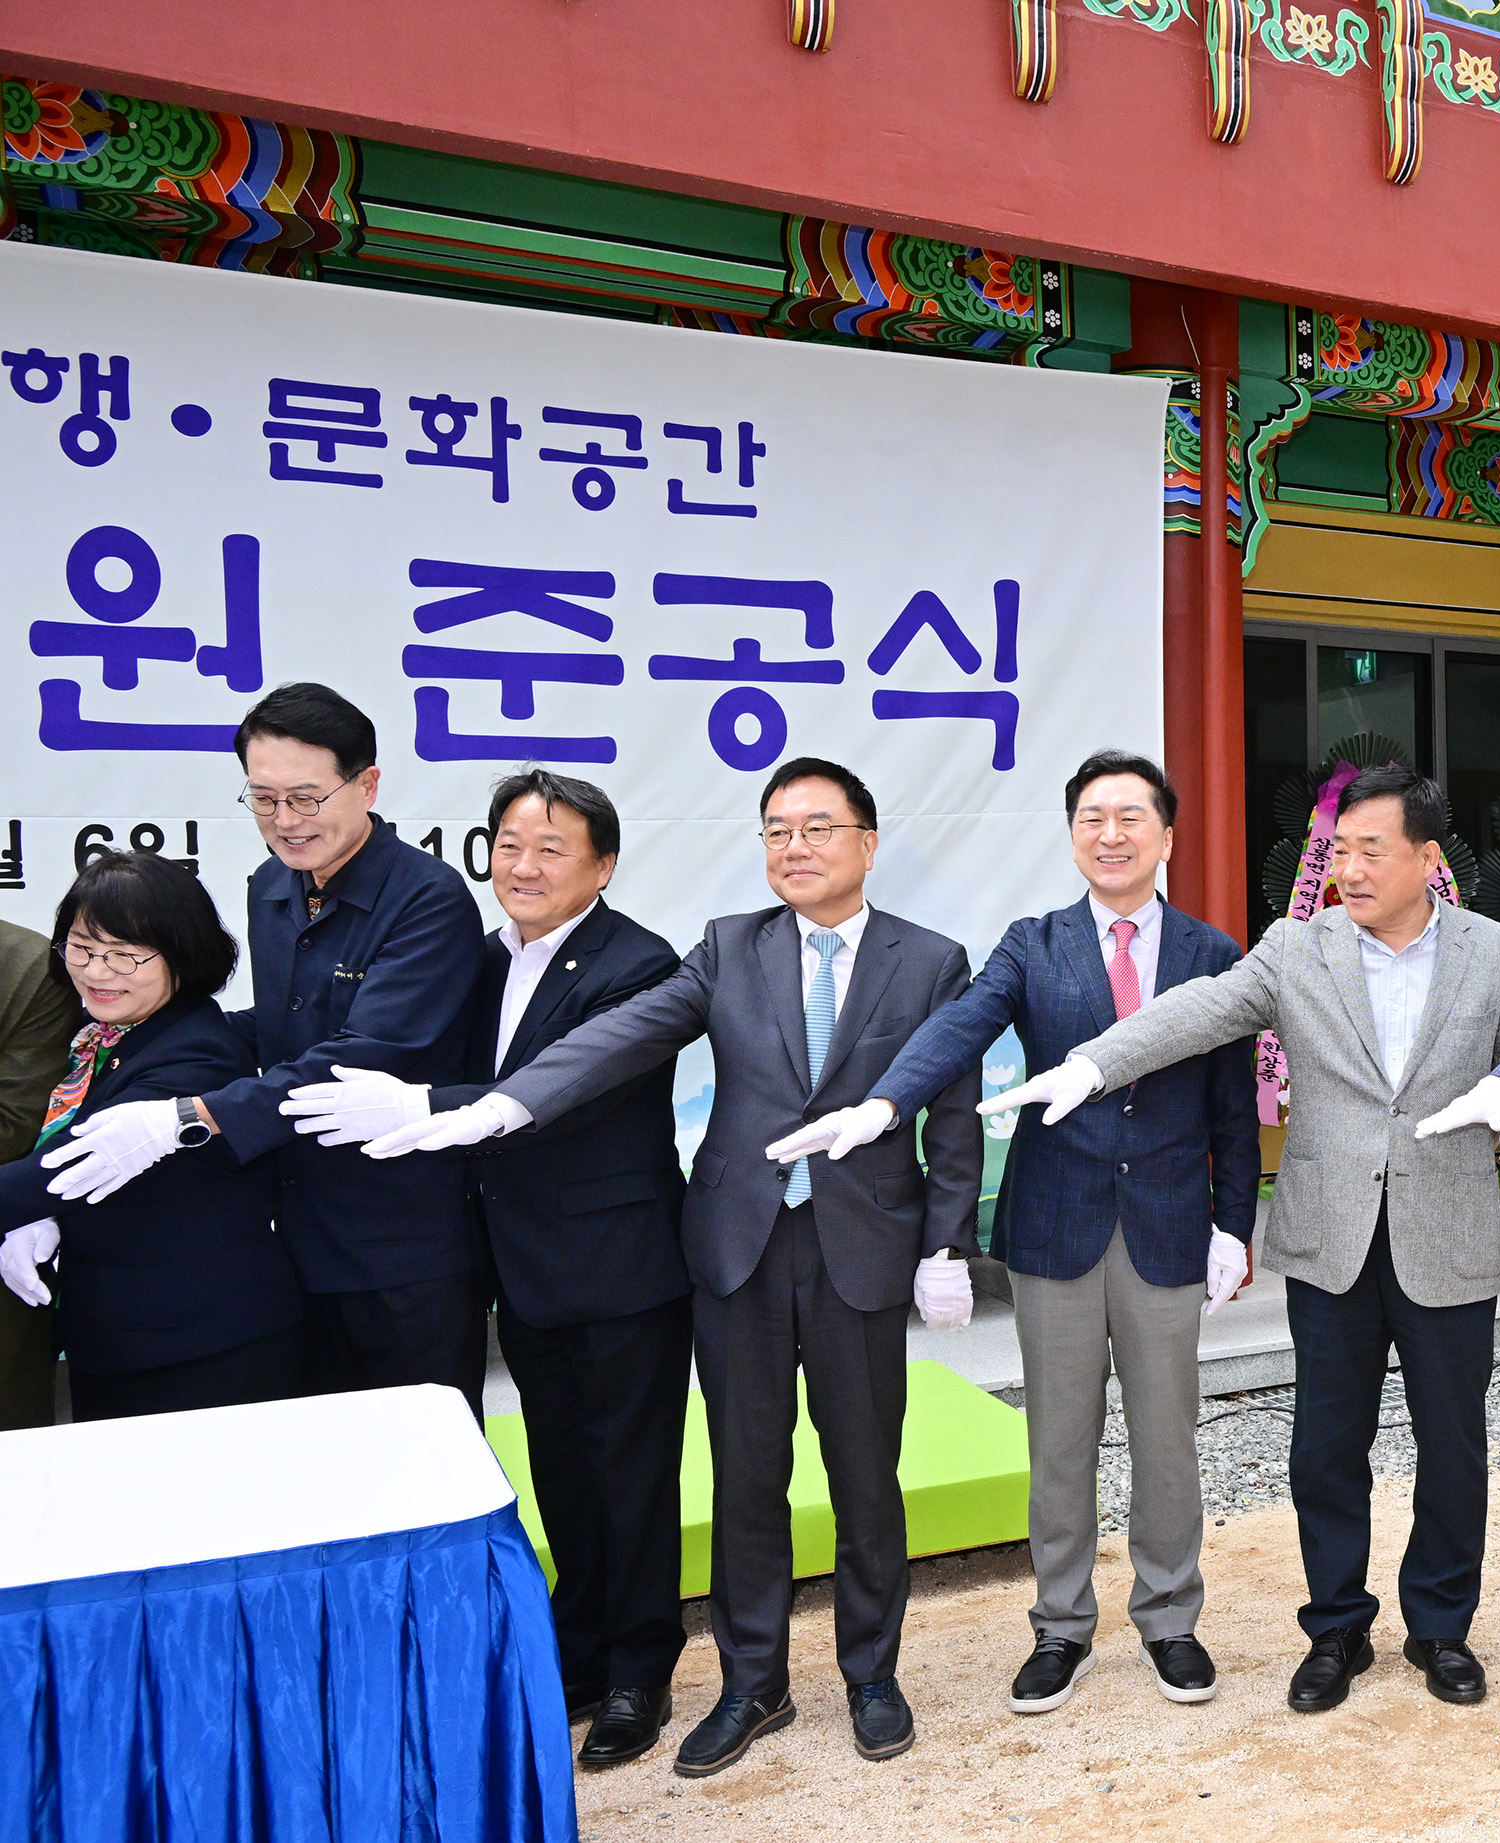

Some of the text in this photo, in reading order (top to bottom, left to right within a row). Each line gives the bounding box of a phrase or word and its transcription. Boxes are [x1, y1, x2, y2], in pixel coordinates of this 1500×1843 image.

[30, 526, 1020, 772] 원 준공식
[1292, 837, 1334, 922] 삼동면 지역사
[1257, 1040, 1283, 1083] 한상준
